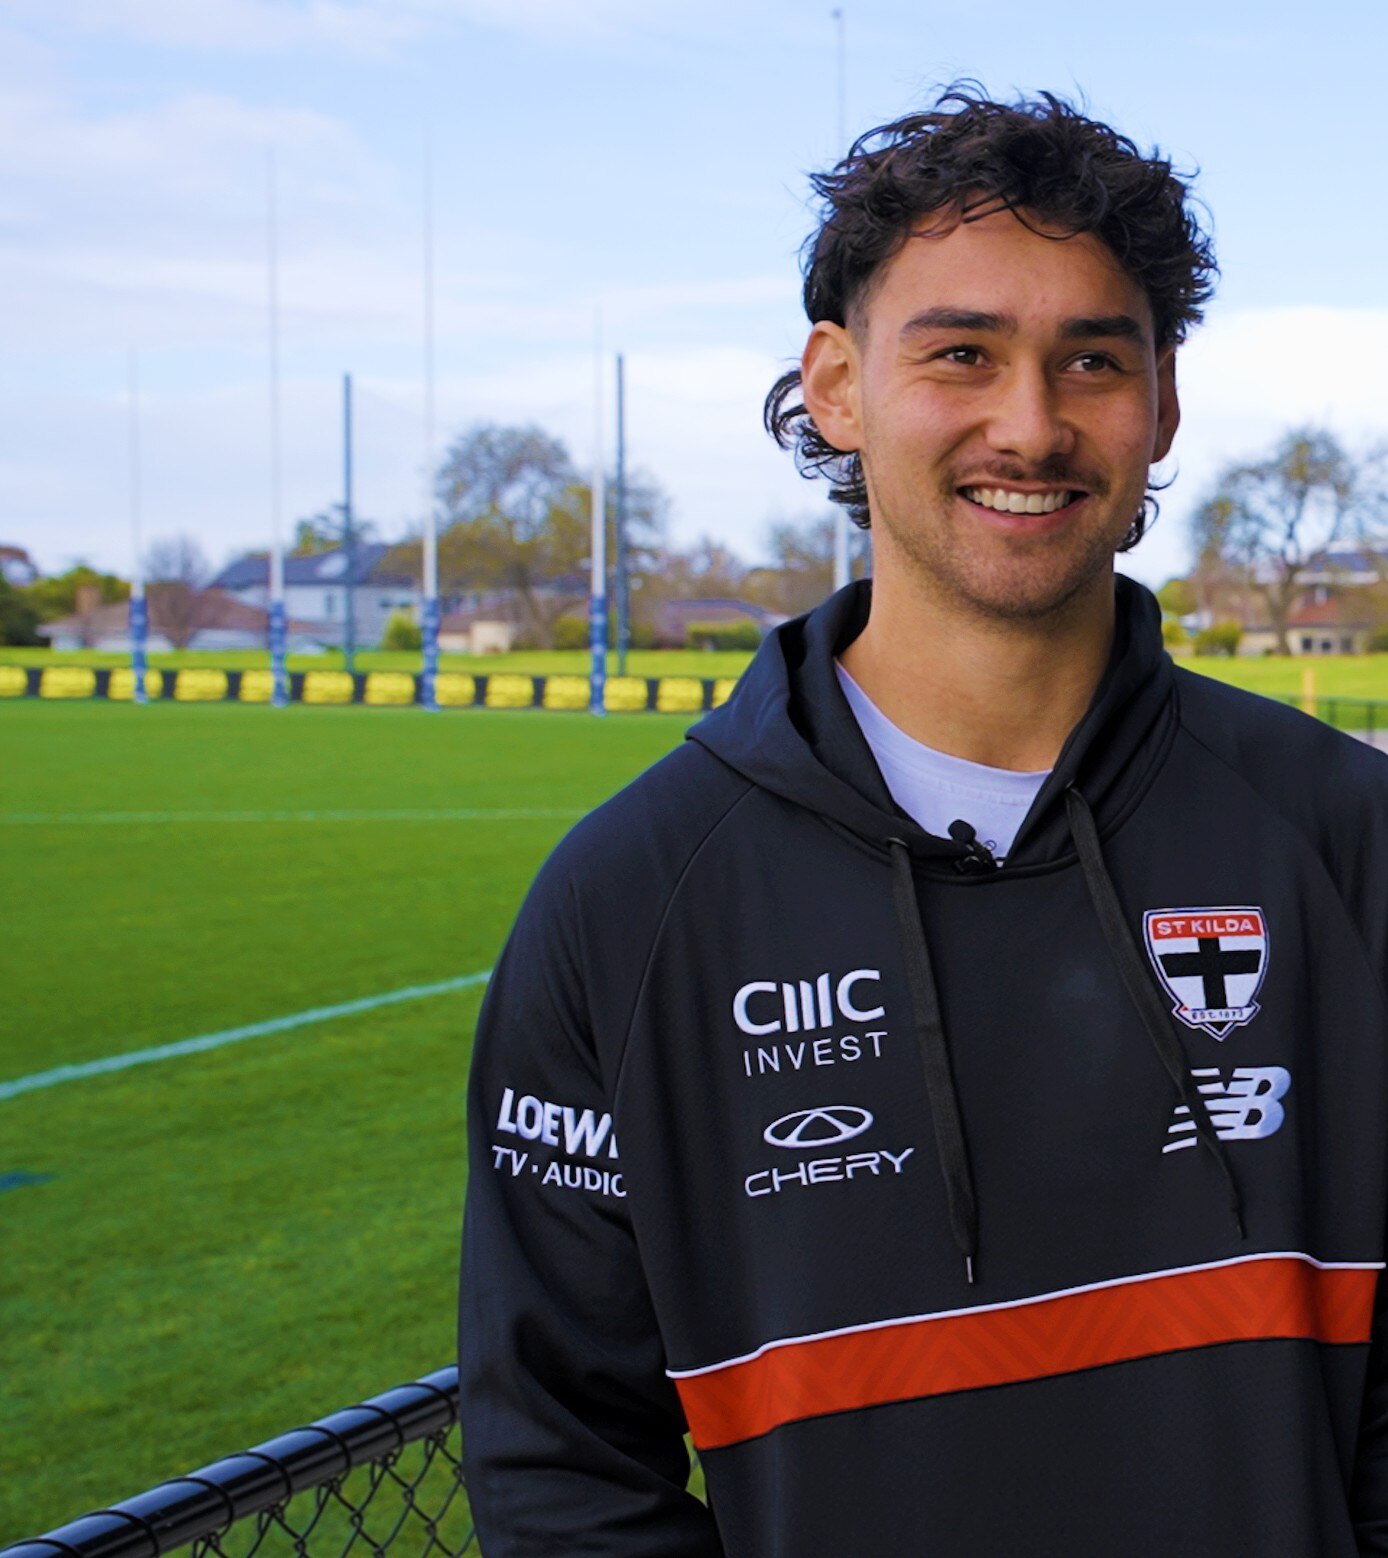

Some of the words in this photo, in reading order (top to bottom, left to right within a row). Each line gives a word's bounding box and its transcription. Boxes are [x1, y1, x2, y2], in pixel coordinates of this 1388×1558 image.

[1157, 920, 1186, 935] ST
[1191, 918, 1255, 934] KILDA
[744, 1031, 888, 1077] INVEST
[745, 1147, 915, 1197] CHERY
